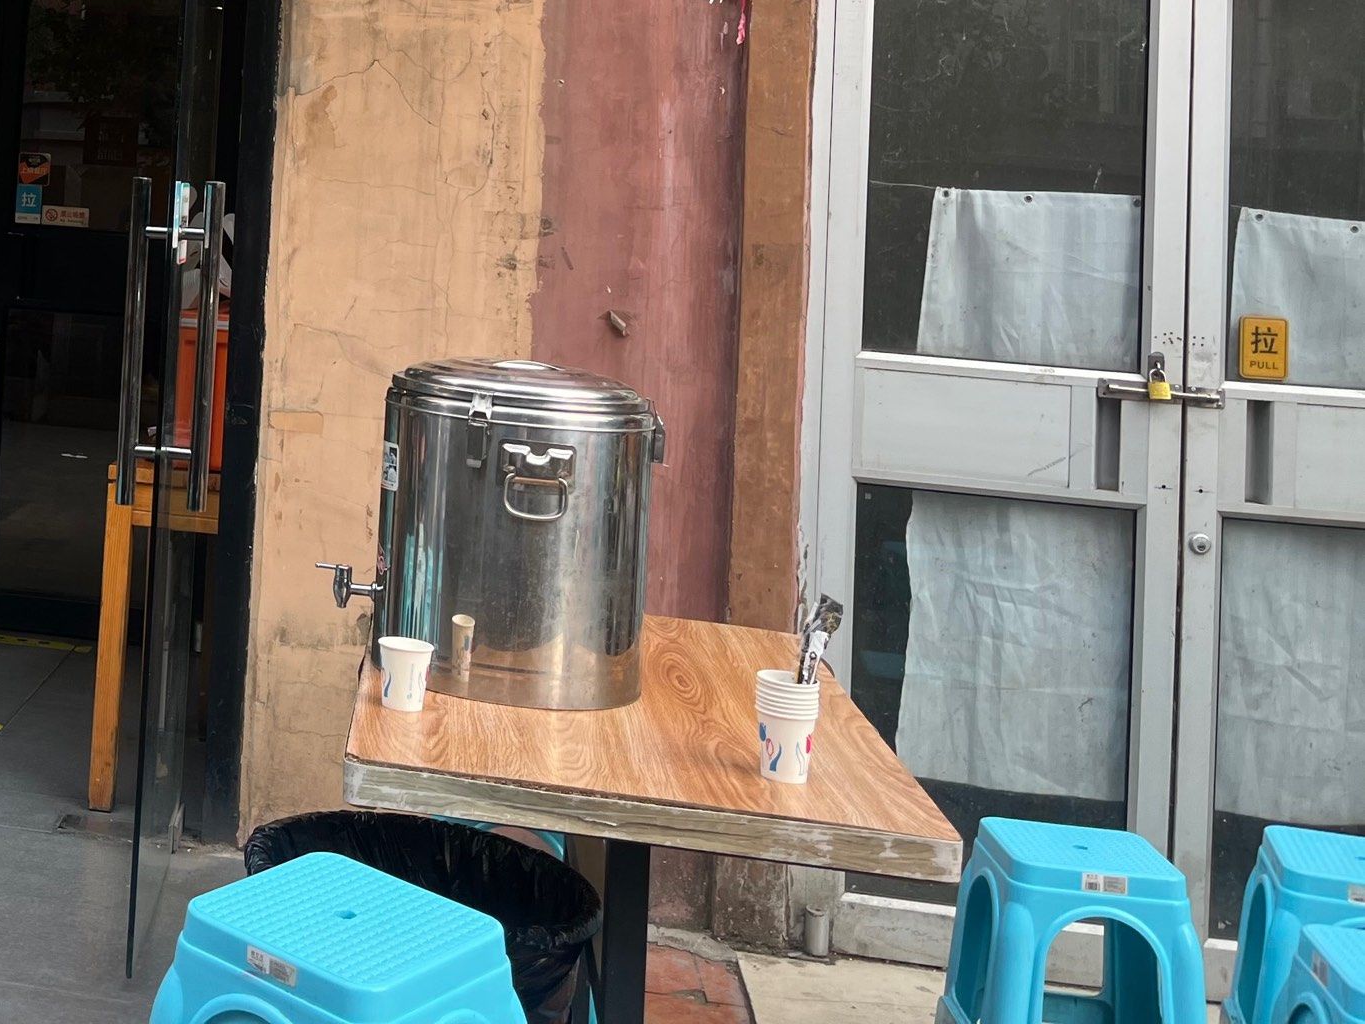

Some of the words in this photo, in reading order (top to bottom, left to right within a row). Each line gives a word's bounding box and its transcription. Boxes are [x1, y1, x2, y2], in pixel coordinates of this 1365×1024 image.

[21, 191, 37, 208] 拉
[1250, 325, 1279, 355] 拉
[1249, 360, 1279, 370] PULL
